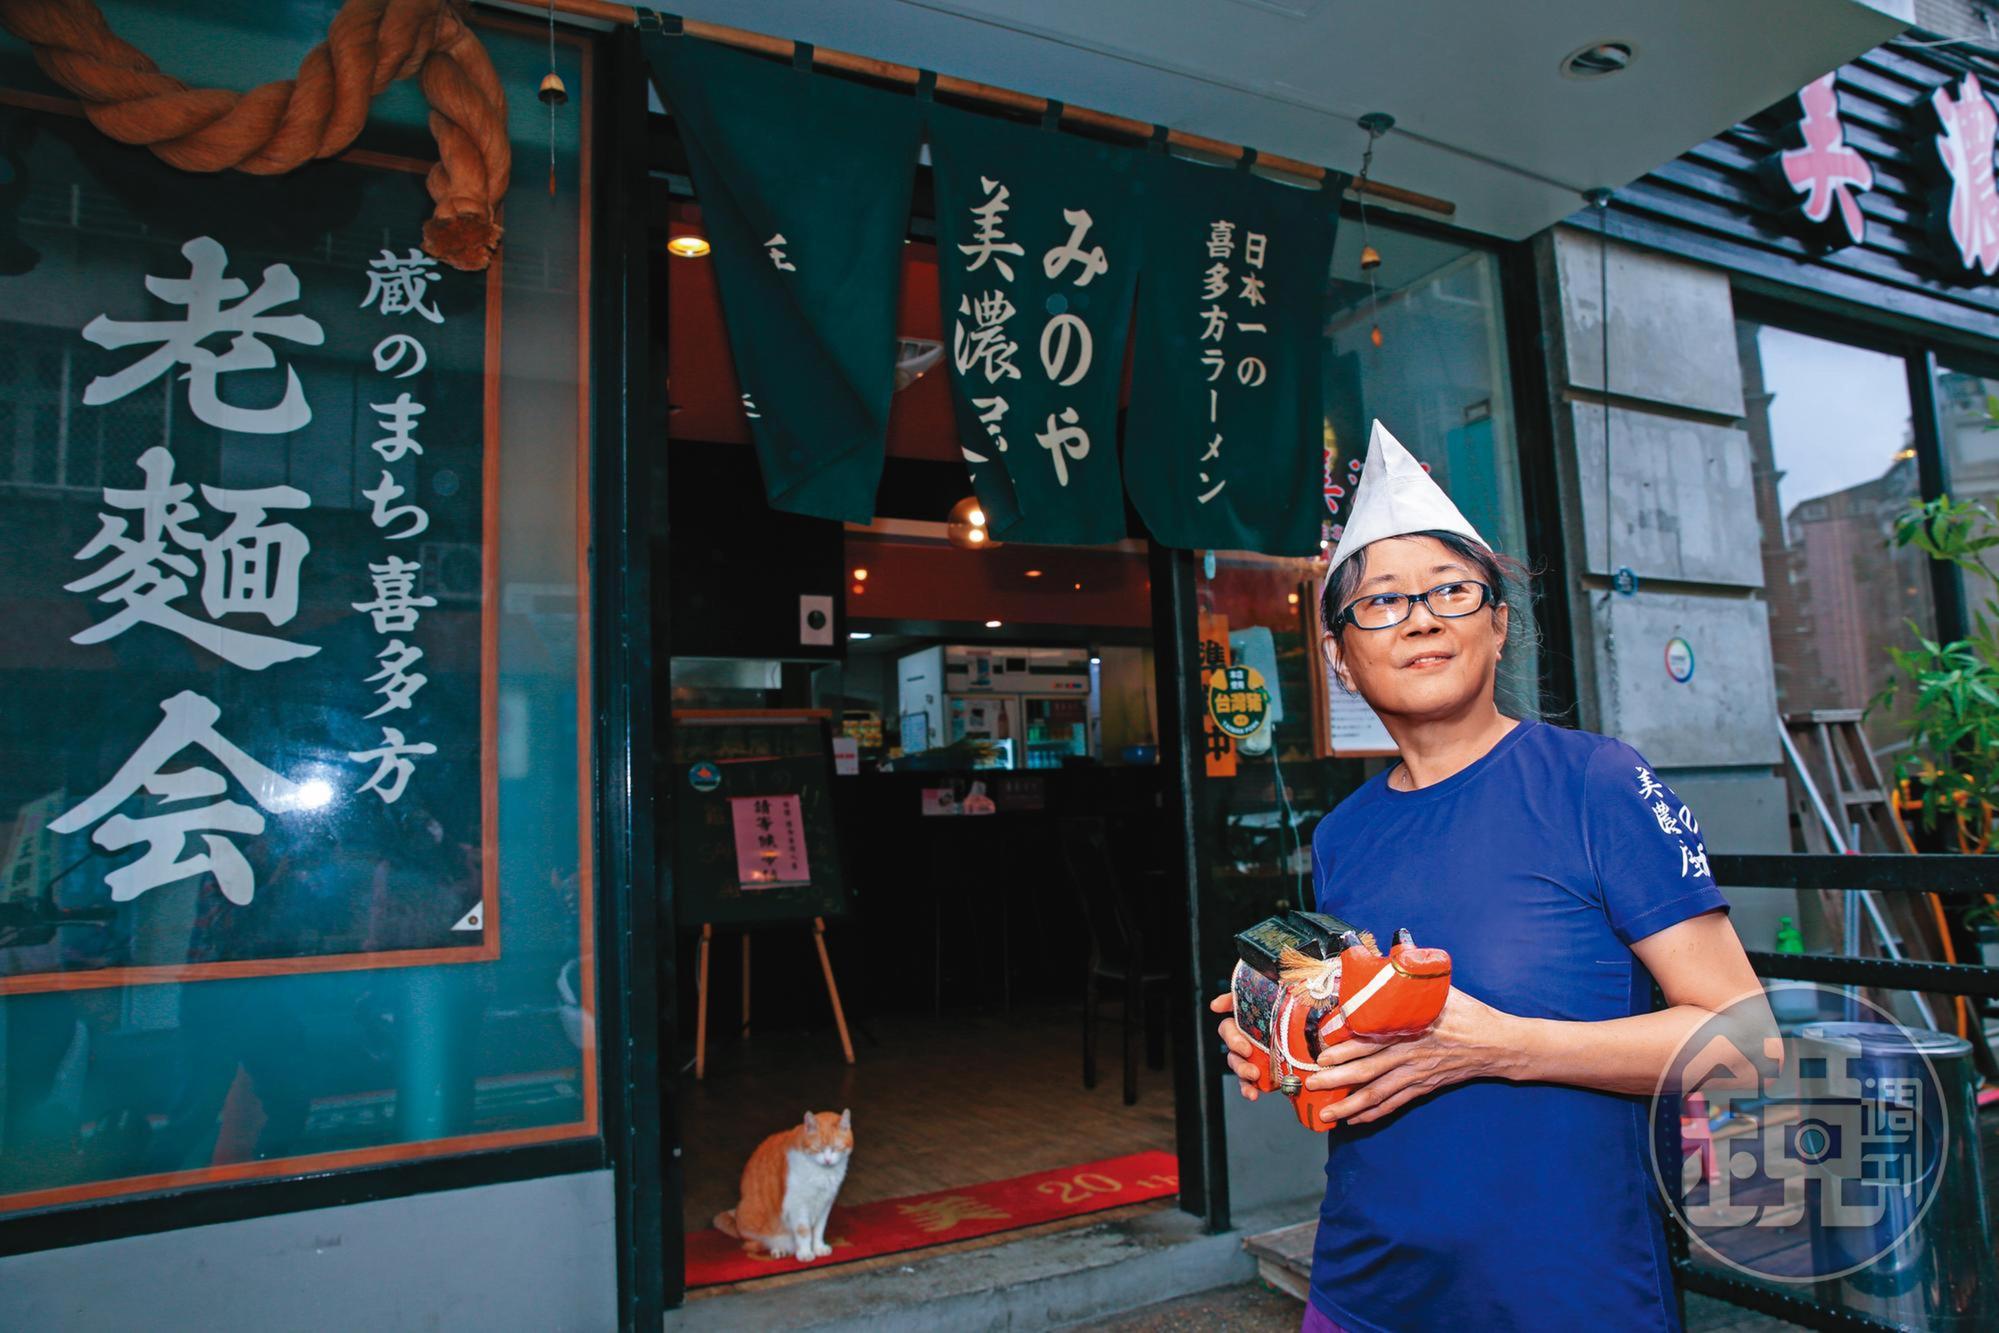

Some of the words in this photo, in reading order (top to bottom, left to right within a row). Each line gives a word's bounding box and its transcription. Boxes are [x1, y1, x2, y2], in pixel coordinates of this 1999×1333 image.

[1035, 208, 1109, 488] みのや
[1198, 220, 1235, 504] 喜多方ラーメン
[1236, 231, 1267, 387] 日本一の
[349, 248, 446, 804] 蔵のまち喜多方
[1038, 1172, 1122, 1204] 20
